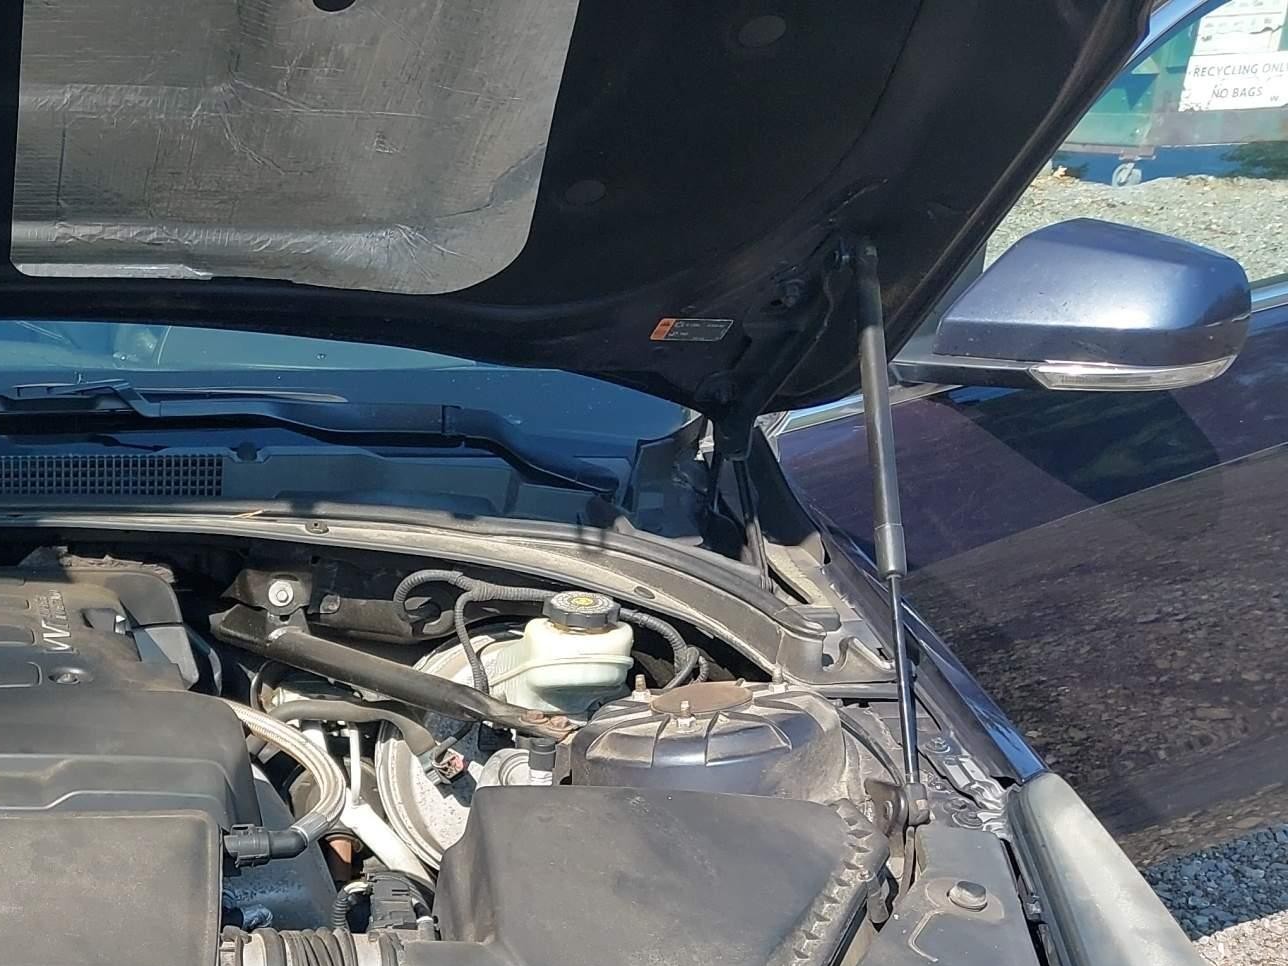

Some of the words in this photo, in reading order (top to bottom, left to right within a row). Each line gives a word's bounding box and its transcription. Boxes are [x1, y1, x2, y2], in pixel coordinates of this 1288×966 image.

[1193, 64, 1259, 77] RECYCLING
[1262, 62, 1288, 73] ONL
[1212, 88, 1229, 98] NO
[1232, 86, 1263, 98] BAGS
